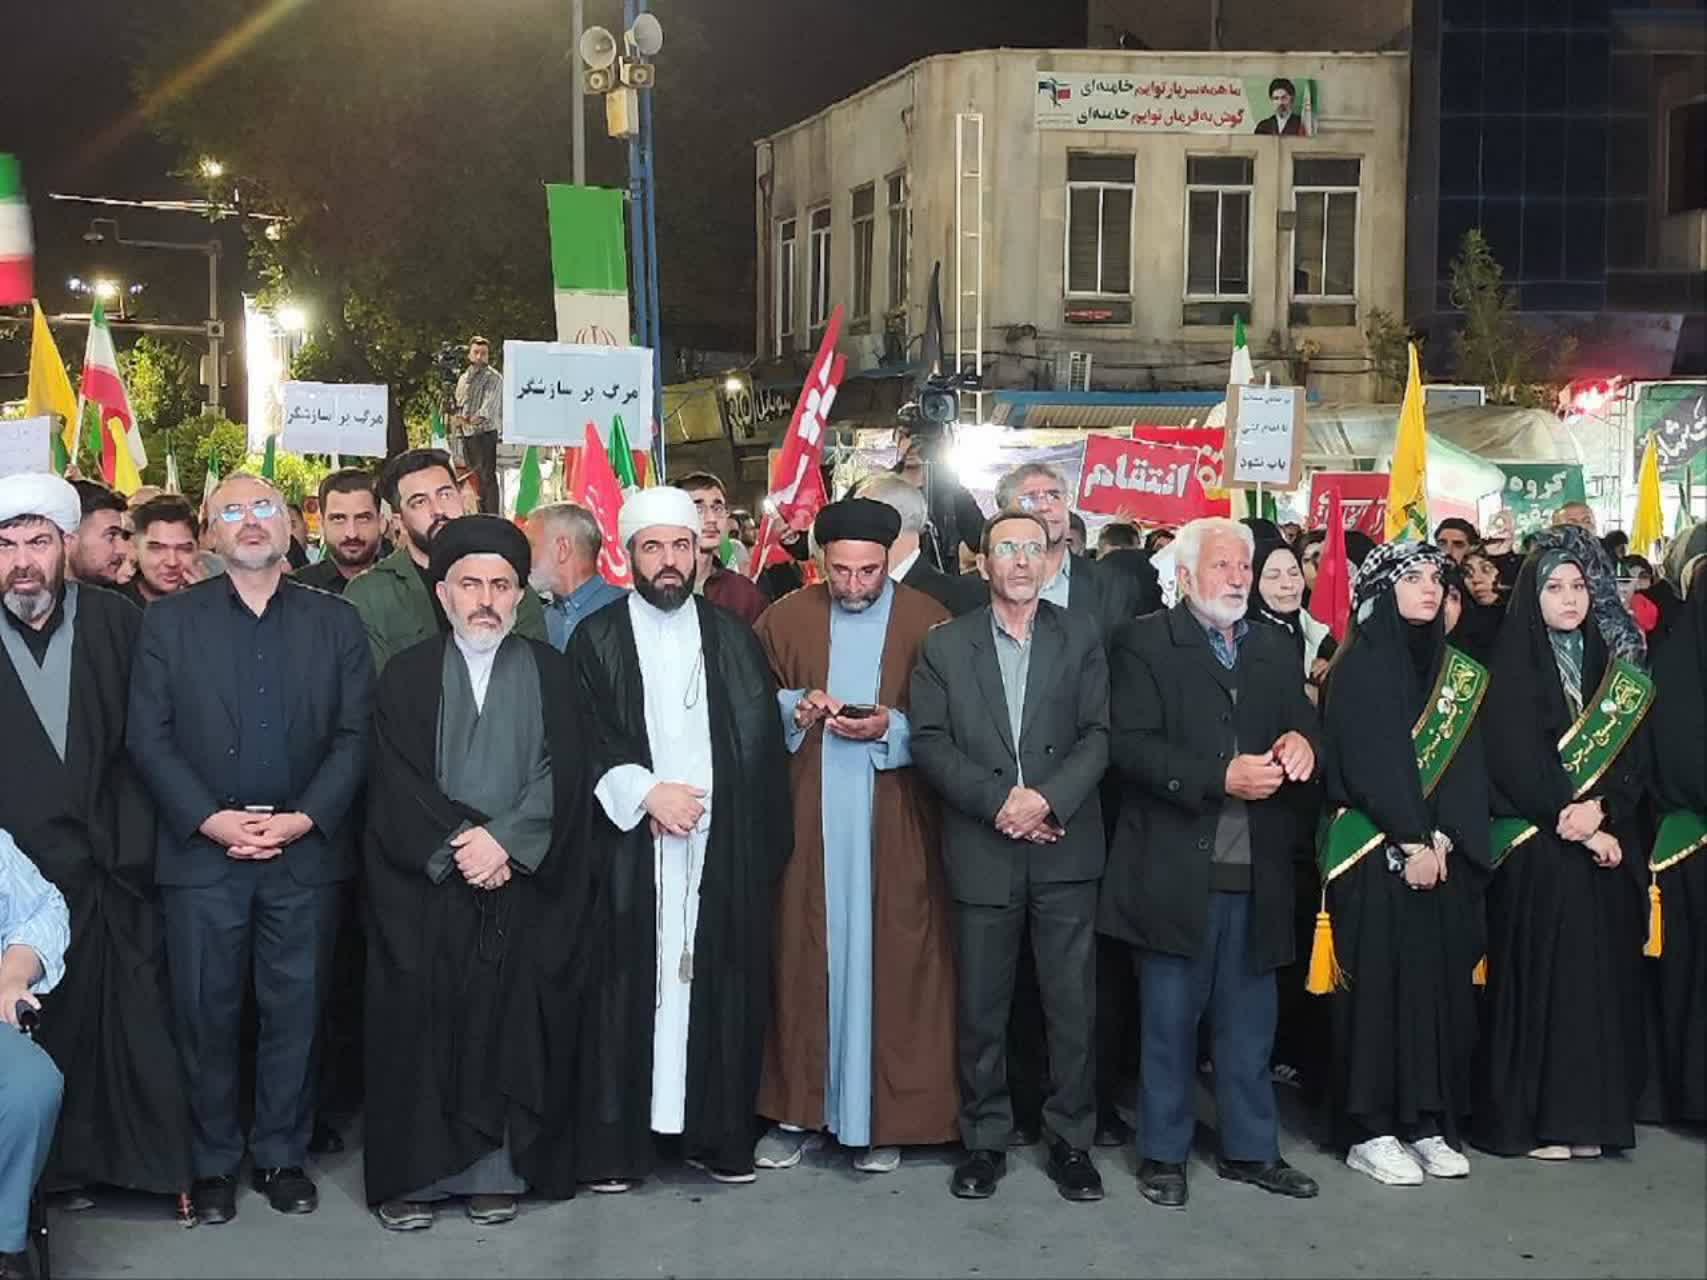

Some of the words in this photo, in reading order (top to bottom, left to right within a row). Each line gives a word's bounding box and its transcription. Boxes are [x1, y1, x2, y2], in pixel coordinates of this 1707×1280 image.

[516, 378, 572, 399] سازشگر
[580, 386, 594, 403] بر
[602, 383, 639, 405] مرگ
[287, 405, 331, 425] سازشگر
[338, 413, 350, 426] بر
[354, 409, 384, 427] مرگ
[1084, 454, 1191, 498] انتقام
[1508, 470, 1567, 500] گروه
[1592, 713, 1623, 747] بسیج
